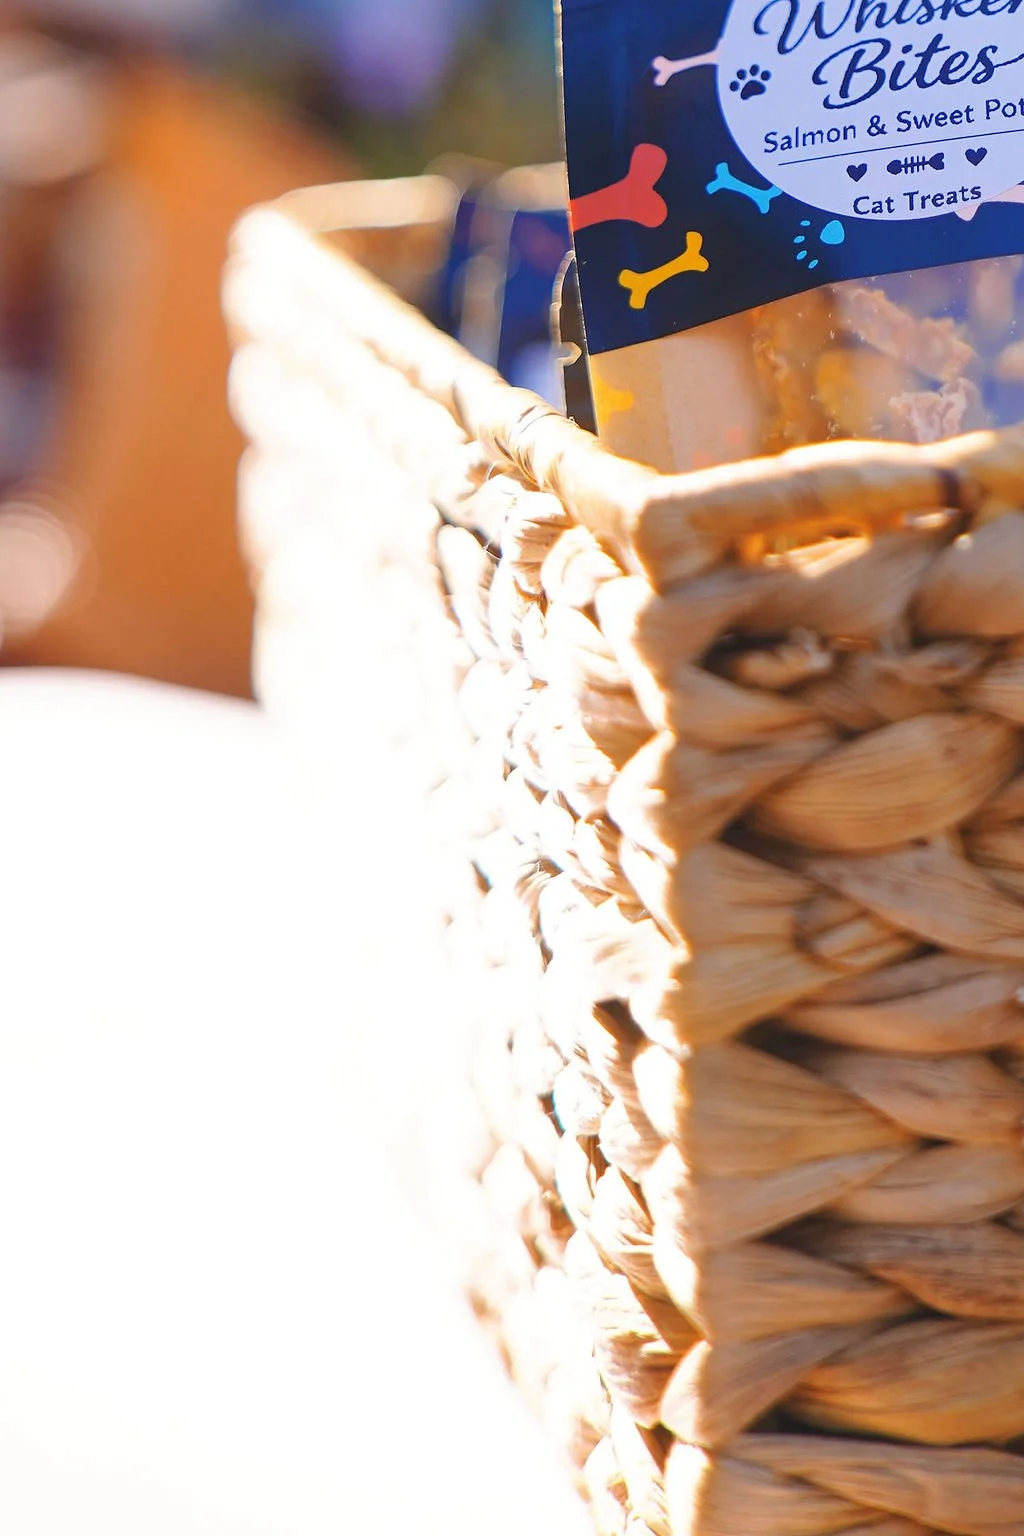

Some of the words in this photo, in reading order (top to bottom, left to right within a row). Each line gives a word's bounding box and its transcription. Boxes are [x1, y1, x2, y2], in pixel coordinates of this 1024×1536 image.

[763, 122, 857, 154] Salmon
[866, 114, 888, 137] &
[896, 104, 976, 133] Sweet
[852, 195, 896, 216] Cat
[902, 183, 983, 213] Treats
